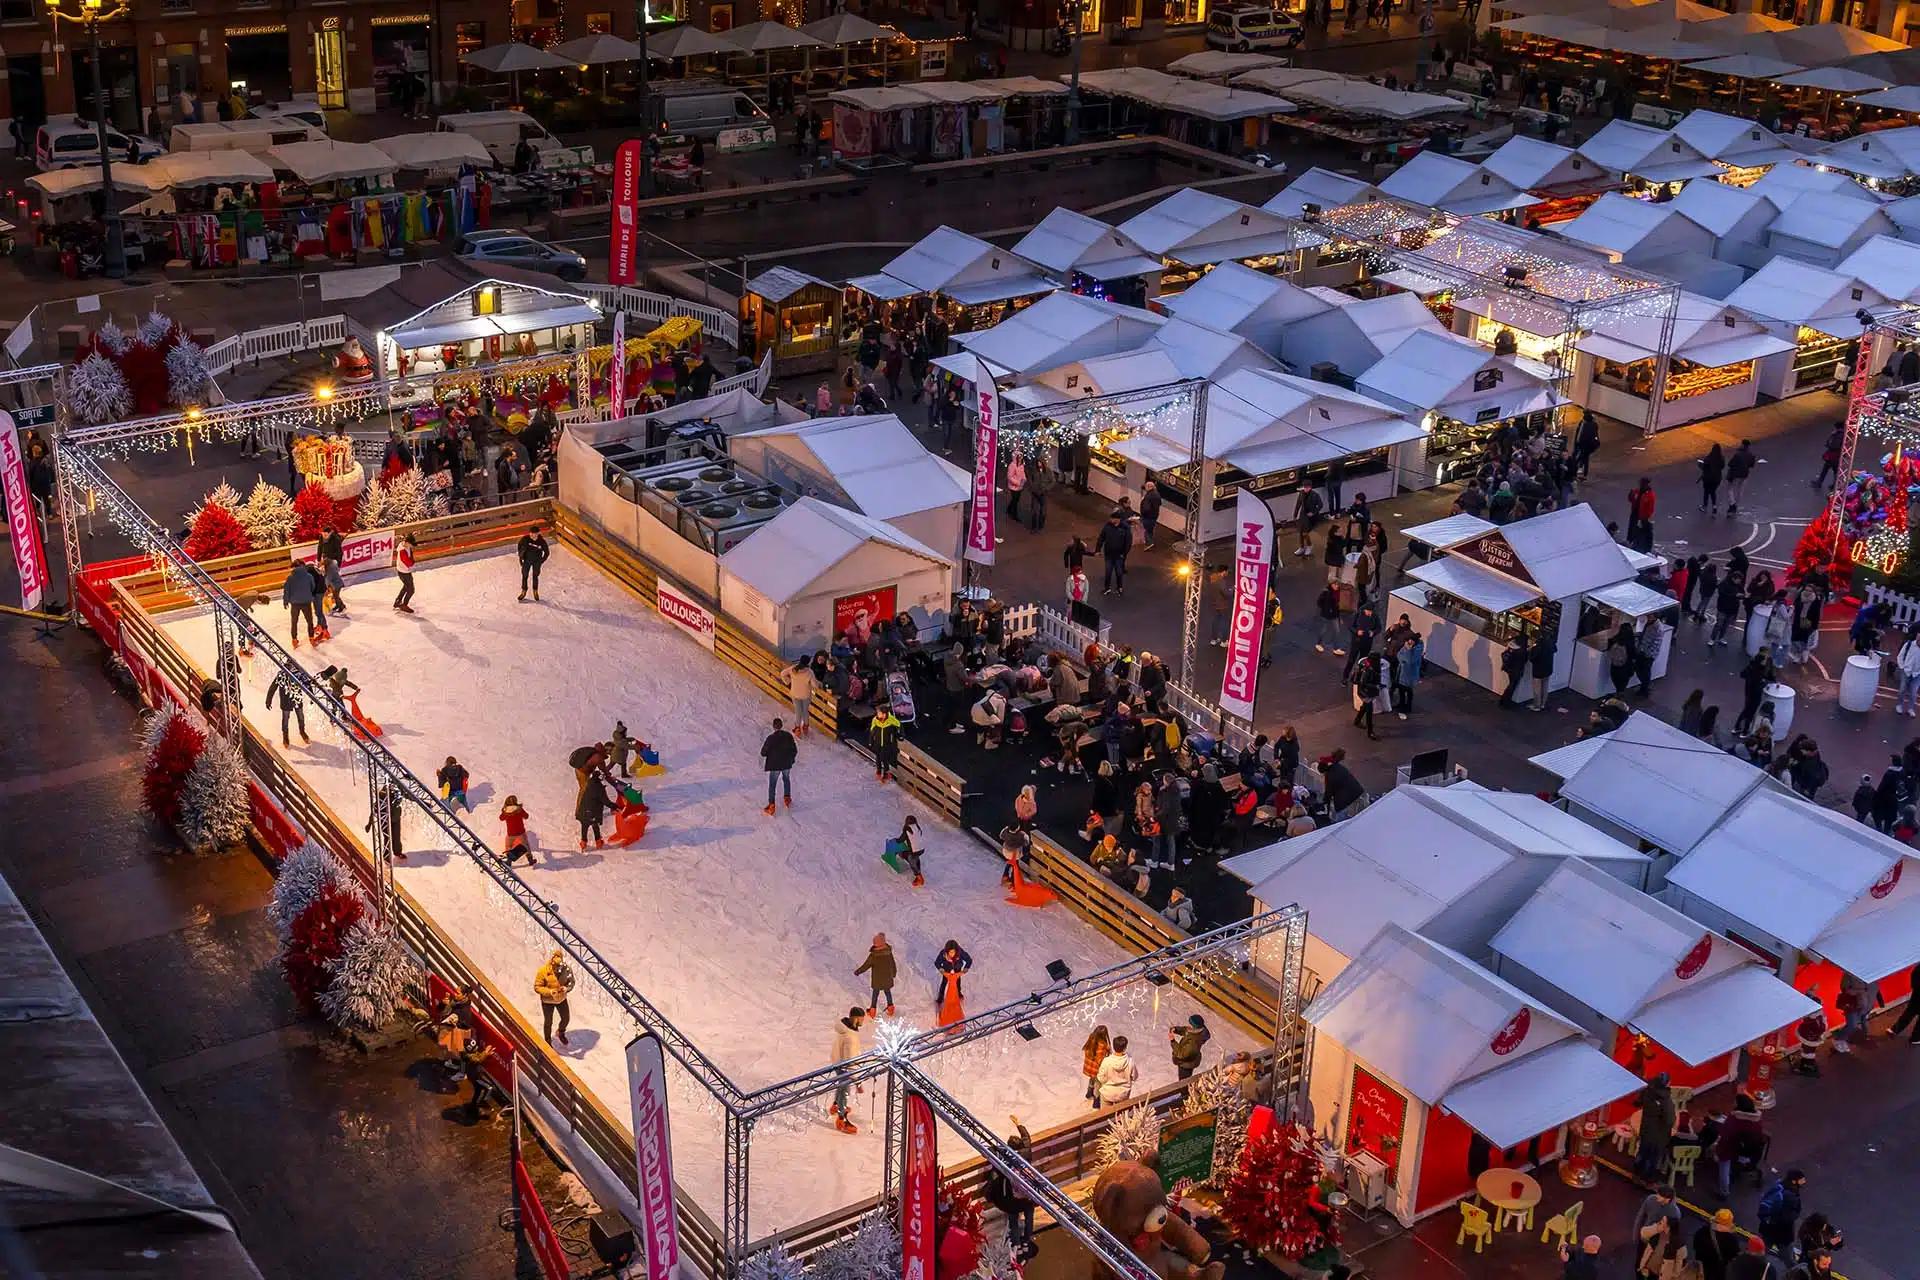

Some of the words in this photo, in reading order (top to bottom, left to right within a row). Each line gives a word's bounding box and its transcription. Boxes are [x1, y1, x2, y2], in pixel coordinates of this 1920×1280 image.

[623, 150, 632, 201] TOULOUSE
[622, 228, 630, 241] DE
[618, 242, 628, 276] MAIRIE
[18, 408, 43, 421] SORTIE
[373, 537, 393, 554] FM
[660, 595, 701, 628] TOULOUSE
[702, 616, 713, 633] FM
